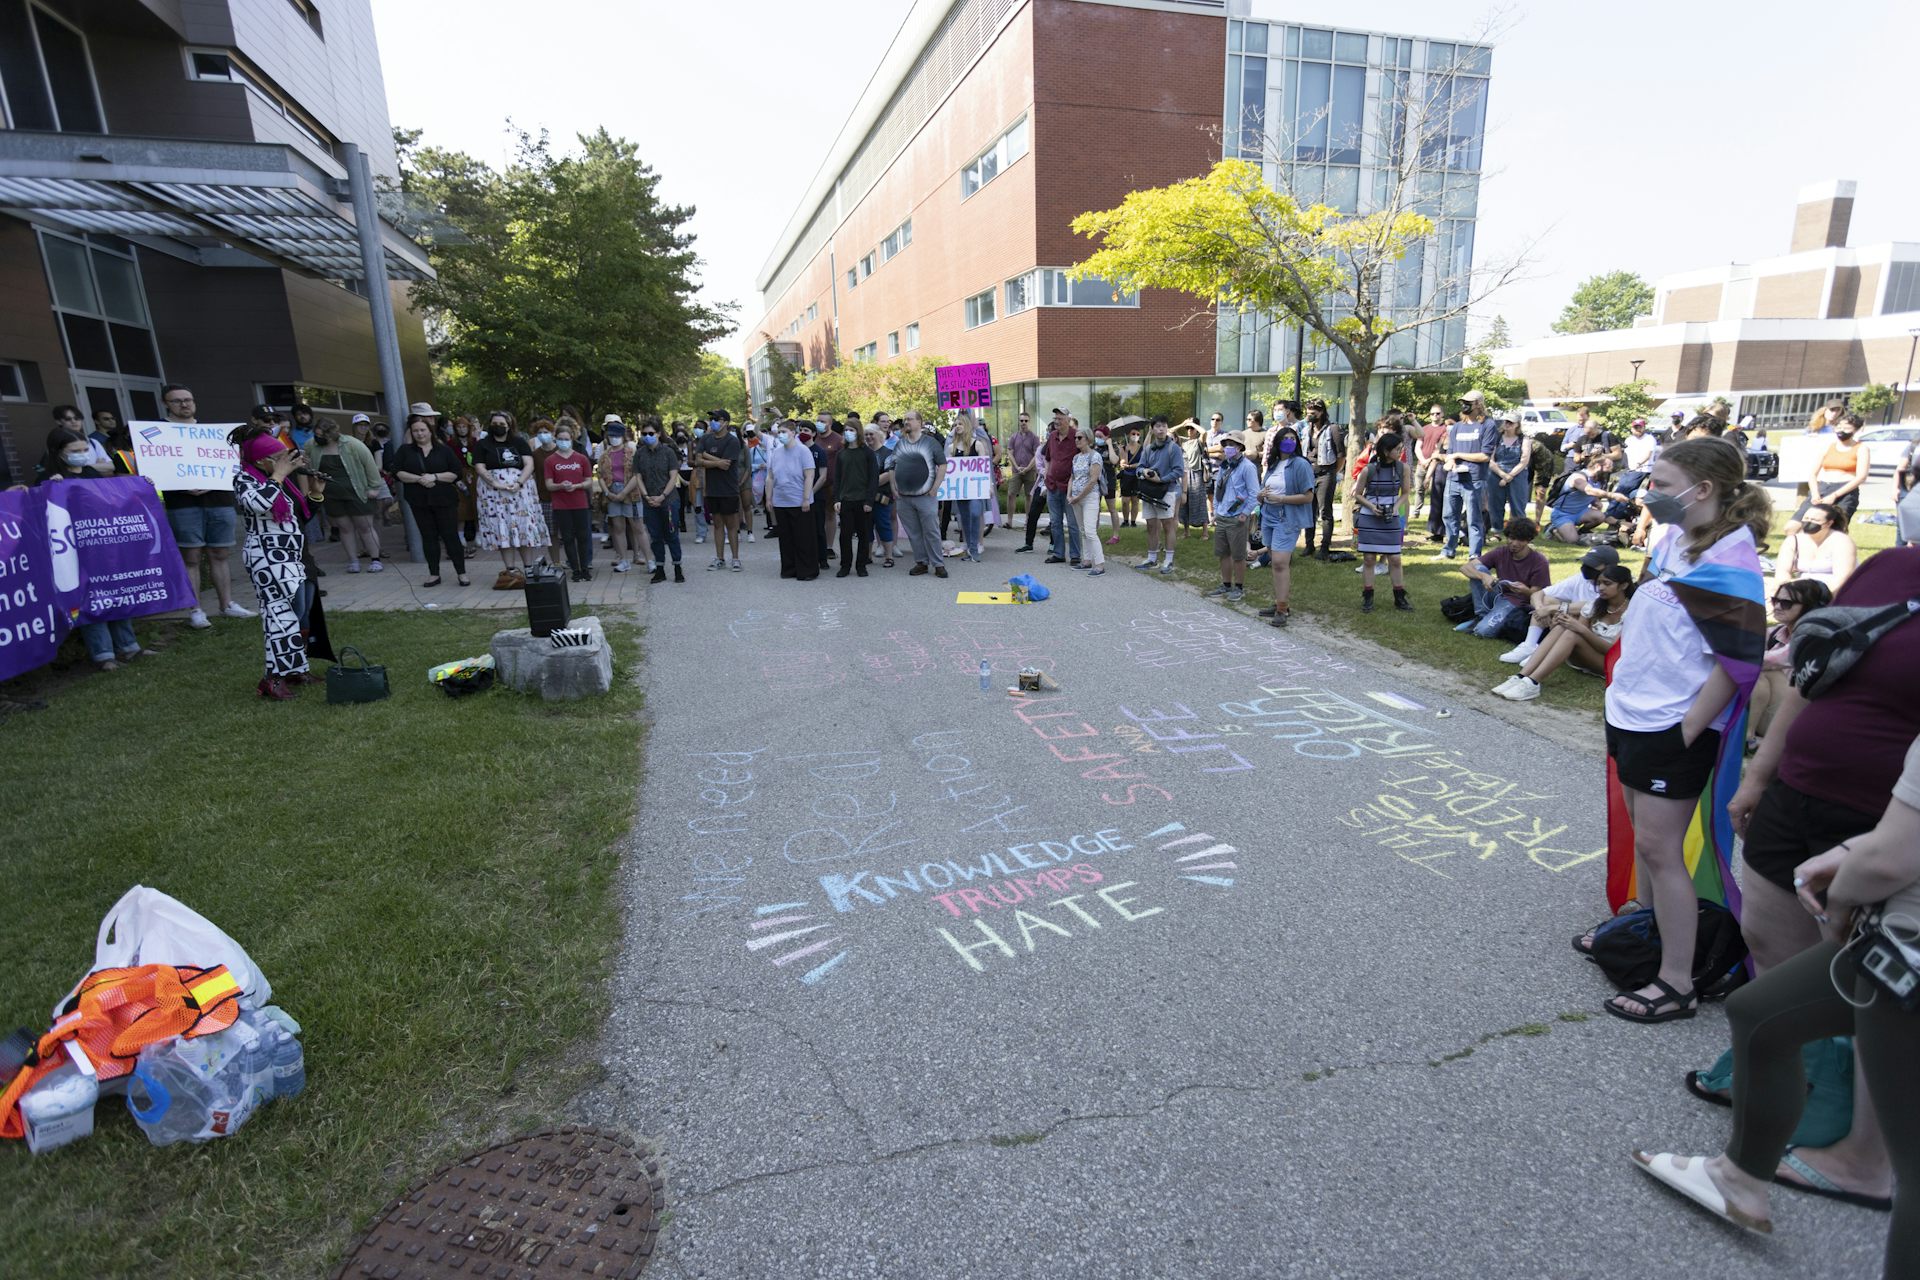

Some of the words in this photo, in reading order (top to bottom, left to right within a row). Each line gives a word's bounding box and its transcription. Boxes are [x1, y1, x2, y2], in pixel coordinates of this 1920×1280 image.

[968, 377, 988, 387] NEED
[970, 366, 987, 377] WHY
[940, 388, 990, 407] PRIDE
[171, 426, 225, 440] TRANS
[140, 444, 184, 458] PEOPLE
[197, 447, 241, 459] DESERV
[176, 463, 226, 479] SAFETY
[555, 462, 581, 471] Google
[960, 457, 990, 473] MORE
[74, 518, 111, 530] SEXUAL
[113, 514, 145, 526] ASSAULT
[76, 526, 118, 540] SUPPORT
[121, 523, 150, 534] CENTRE
[85, 535, 129, 547] WATERLOO
[130, 532, 154, 542] REGION
[96, 589, 118, 598] Hour
[120, 582, 147, 594] Support
[147, 581, 165, 589] Line
[90, 589, 168, 612] 519.741.8633
[1218, 697, 1362, 761] OUR
[1258, 684, 1436, 757] RIGHT
[1113, 724, 1161, 754] AND
[1119, 702, 1256, 774] LIFE
[1007, 697, 1173, 805] SAFETY
[1366, 794, 1498, 860] WAS
[1335, 807, 1455, 879] THIS
[819, 828, 1136, 913] KNOWLEDGE
[932, 863, 1103, 917] TRUMPS
[935, 880, 1164, 973] HATE
[447, 1223, 556, 1268] DANGER
